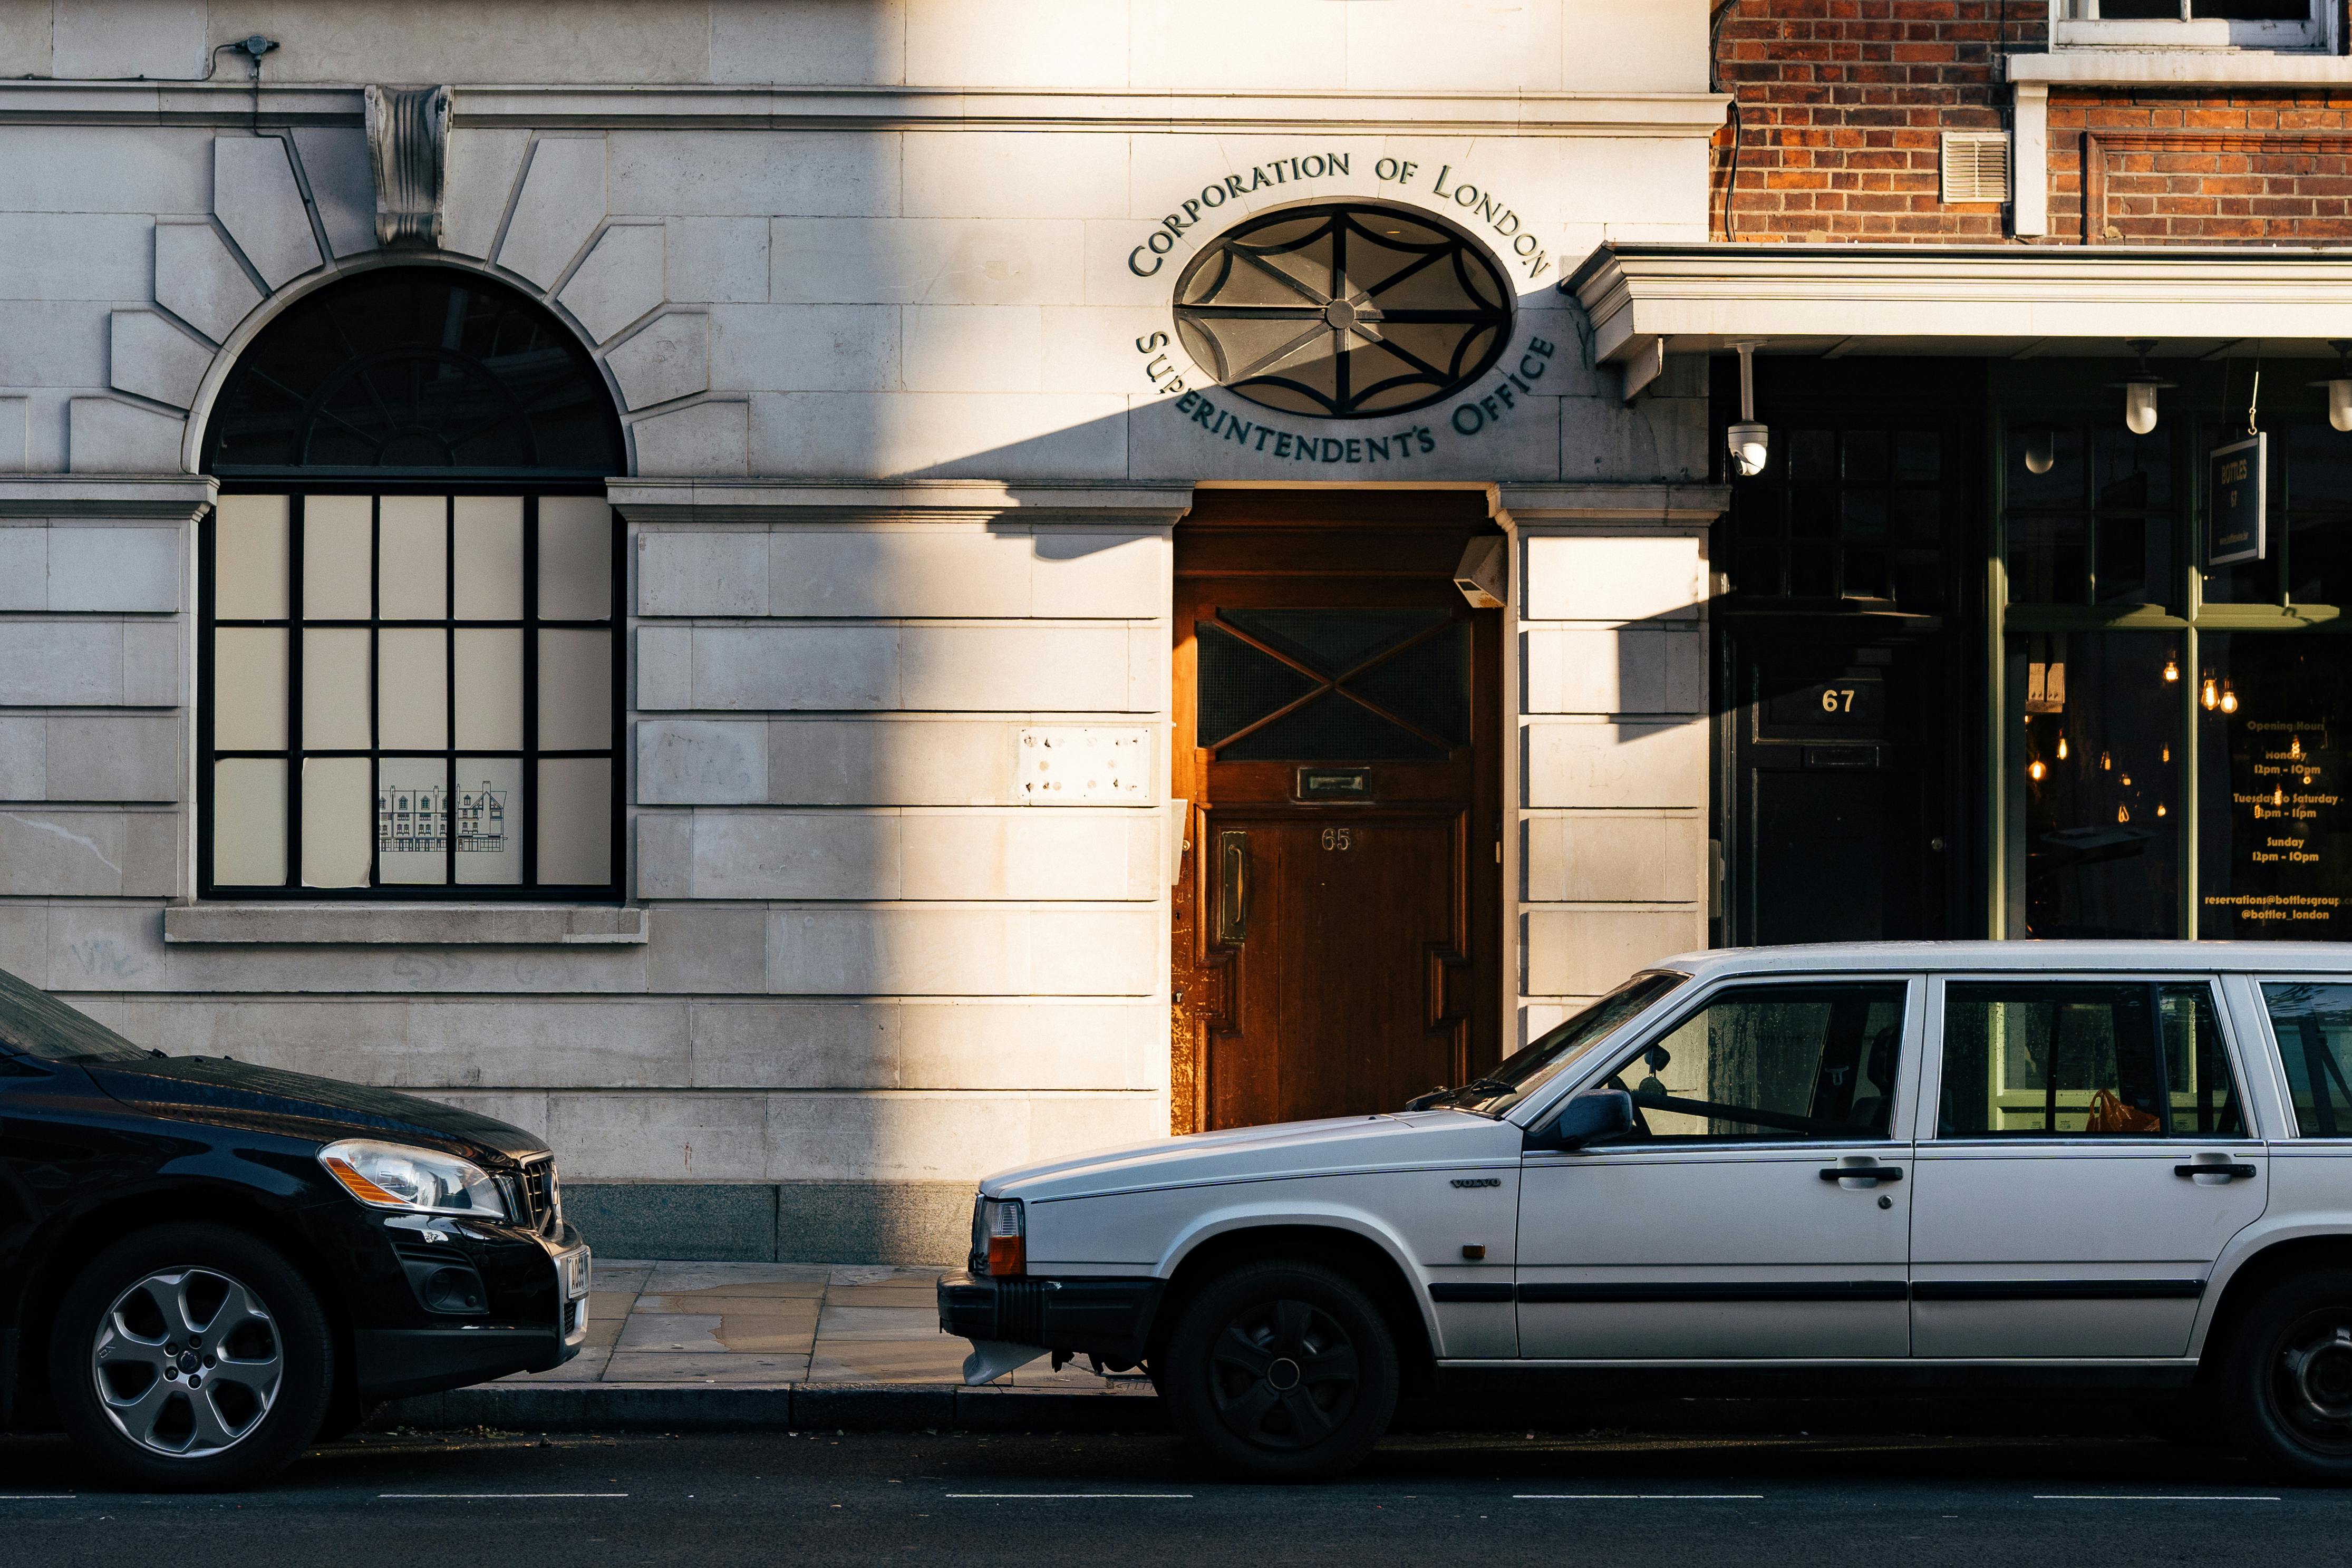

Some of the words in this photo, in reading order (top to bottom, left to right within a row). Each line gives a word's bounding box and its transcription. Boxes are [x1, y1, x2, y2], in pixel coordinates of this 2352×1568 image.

[1128, 153, 1350, 277] CORPORATION
[1433, 164, 1551, 279] LONDON
[1451, 336, 1556, 436] OFFICE
[2221, 458, 2247, 485] BOTTLES
[1823, 690, 1854, 712] 67
[2247, 720, 2293, 732] Opening
[2254, 764, 2280, 776] 12pm
[2291, 764, 2321, 776] 10pm
[2233, 793, 2274, 805] Tuesday
[2292, 793, 2338, 805] Saturday
[2292, 808, 2316, 819] 11pm
[1322, 828, 1351, 850] 65
[2267, 836, 2305, 848] Sunday
[2252, 851, 2279, 863] 12pm
[2289, 851, 2319, 863] 10pm
[2242, 909, 2329, 921] @bottles_london
[1450, 1178, 1502, 1188] VOLVO
